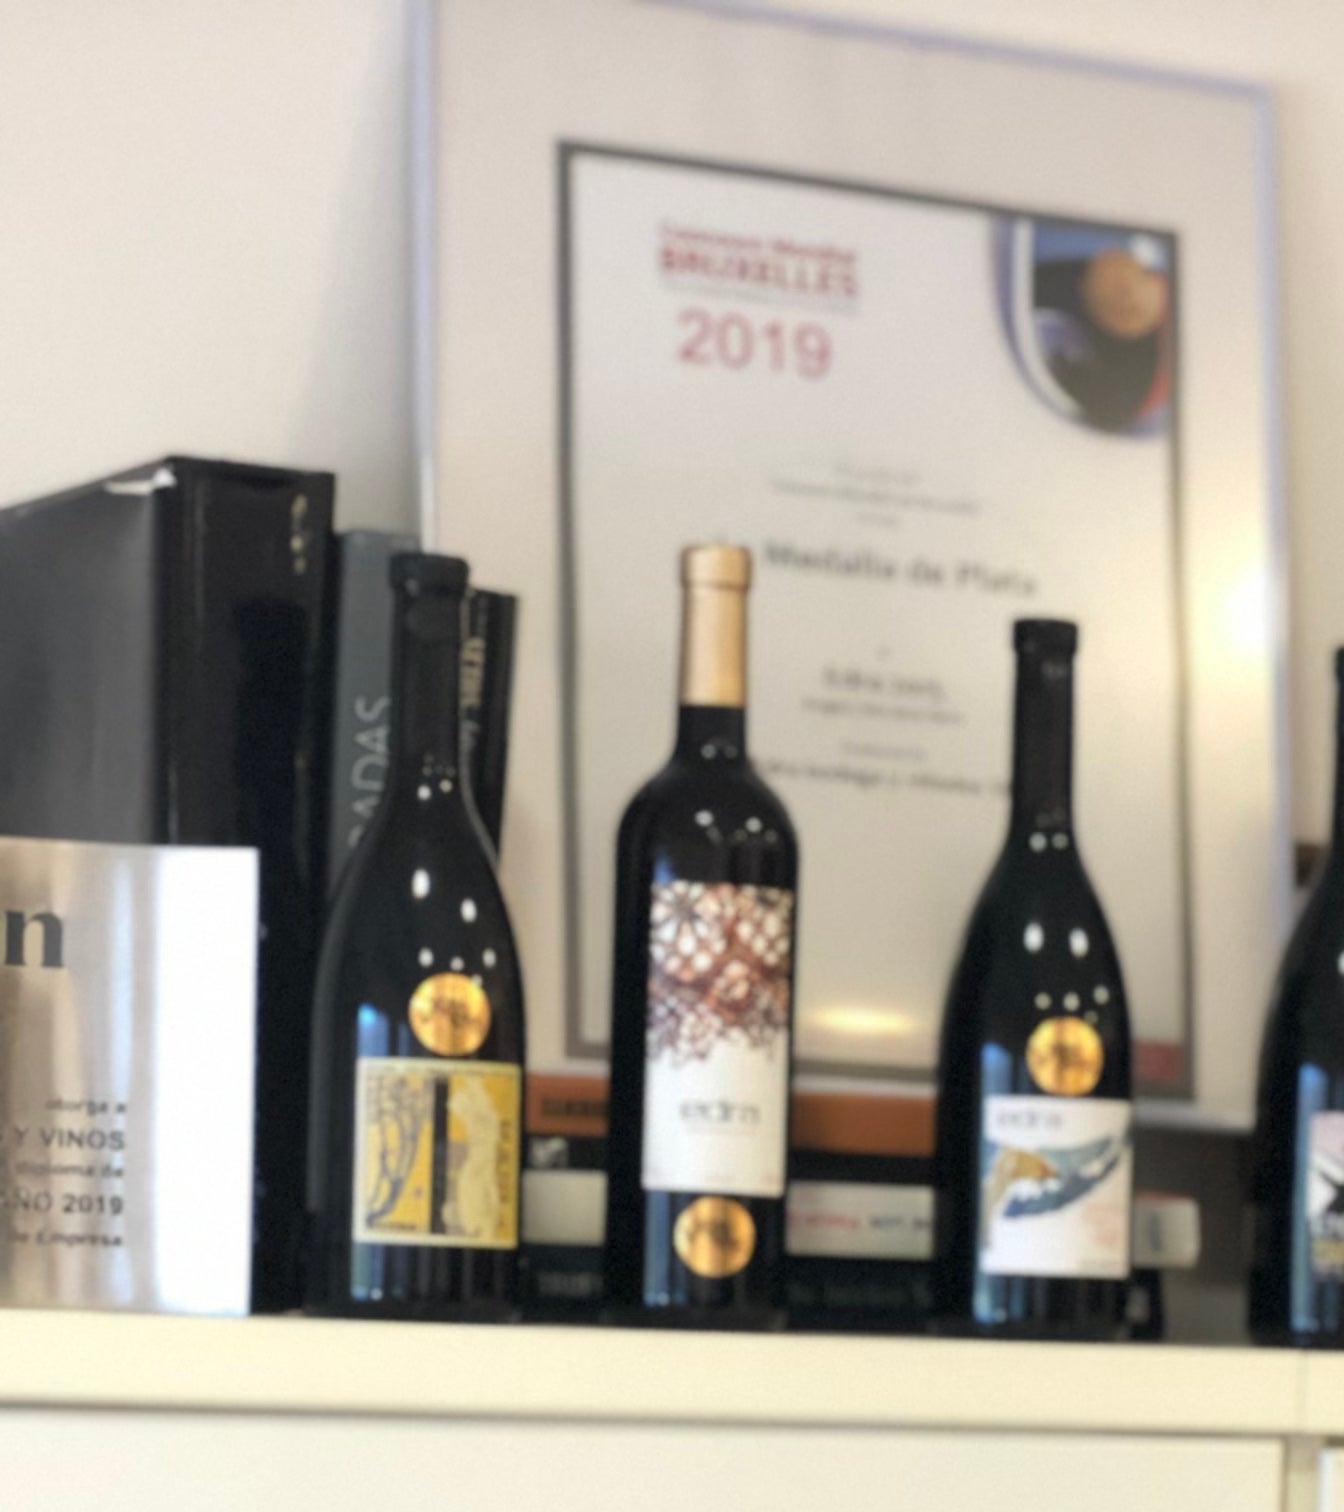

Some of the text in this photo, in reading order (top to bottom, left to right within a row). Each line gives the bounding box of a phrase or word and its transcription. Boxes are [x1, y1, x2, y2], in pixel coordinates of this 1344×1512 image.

[676, 307, 833, 381] 2019
[39, 1128, 125, 1151] VINOS
[62, 1193, 124, 1216] 2019
